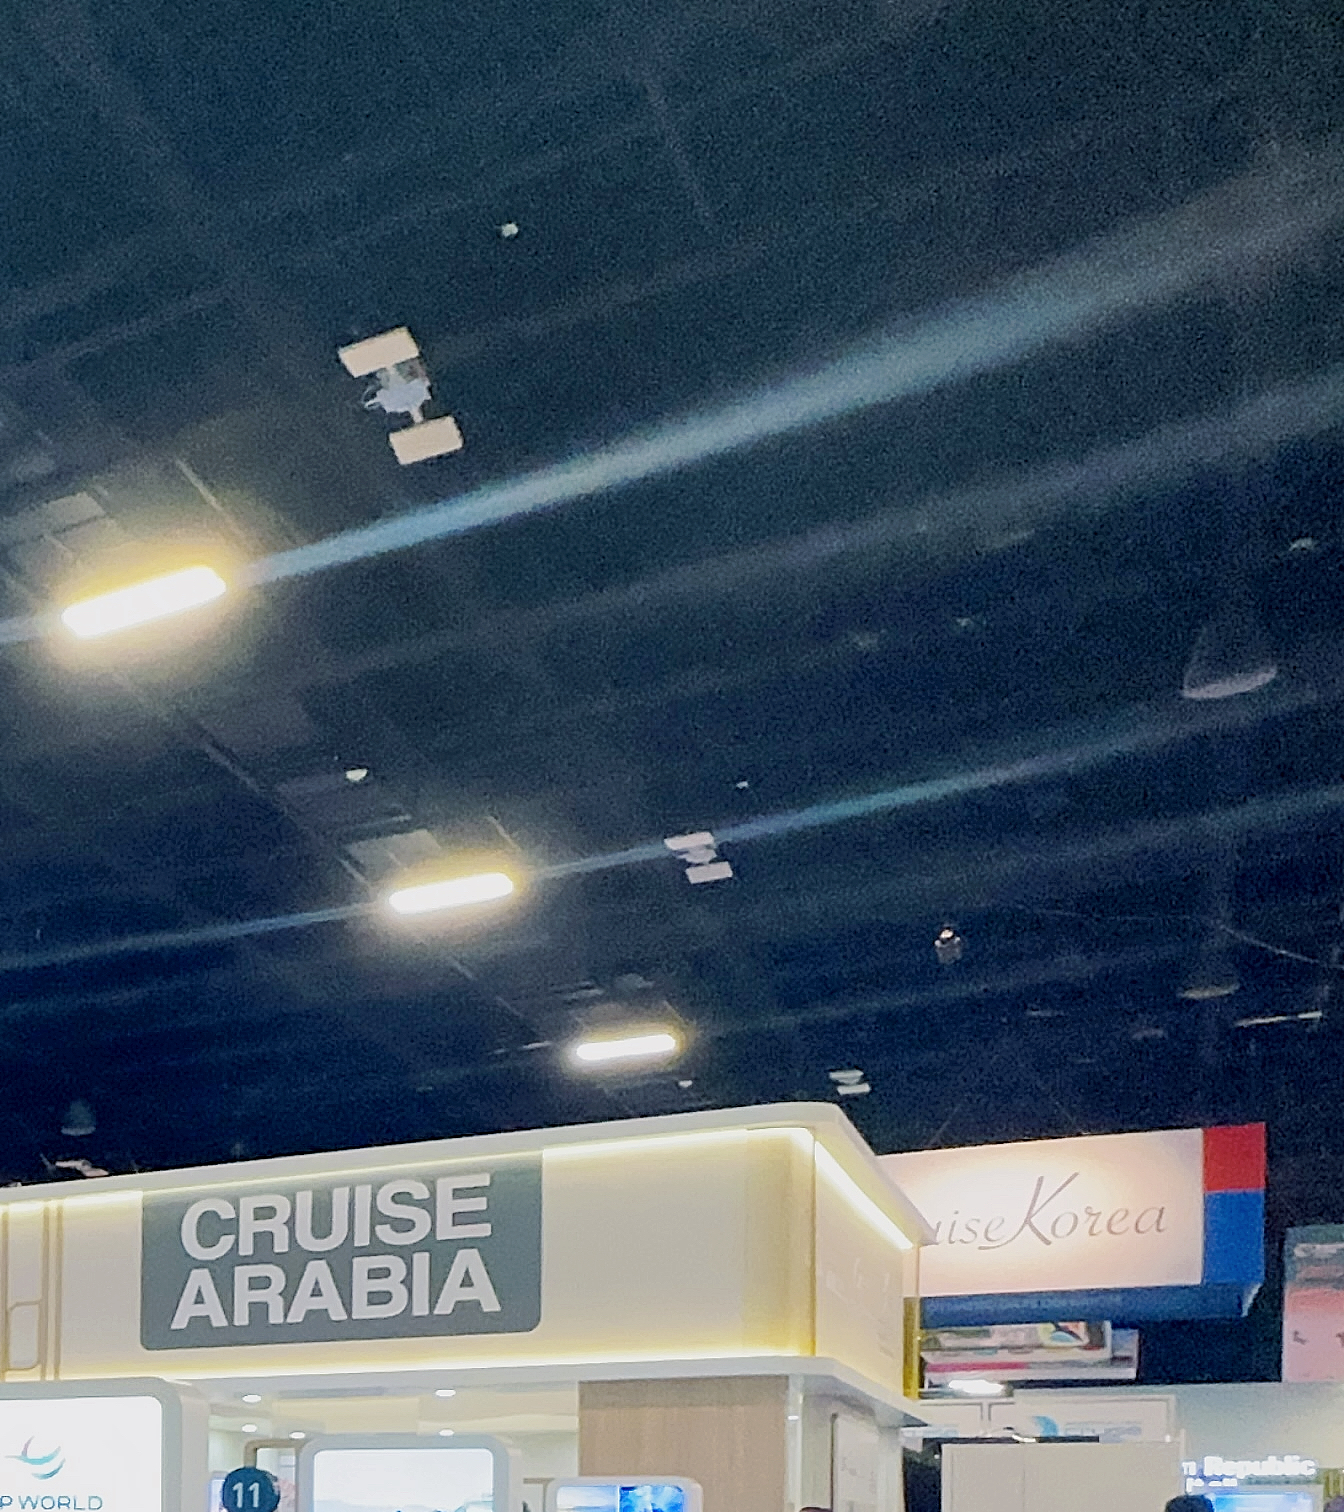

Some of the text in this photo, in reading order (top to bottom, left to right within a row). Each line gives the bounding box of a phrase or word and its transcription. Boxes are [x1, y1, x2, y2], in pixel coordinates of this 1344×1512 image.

[181, 1172, 492, 1261] CRUISE
[978, 1171, 1167, 1251] Korea
[170, 1248, 501, 1330] ARABIA
[1203, 1455, 1317, 1479] Republic
[18, 1495, 104, 1511] WORLD
[232, 1482, 260, 1508] 11
